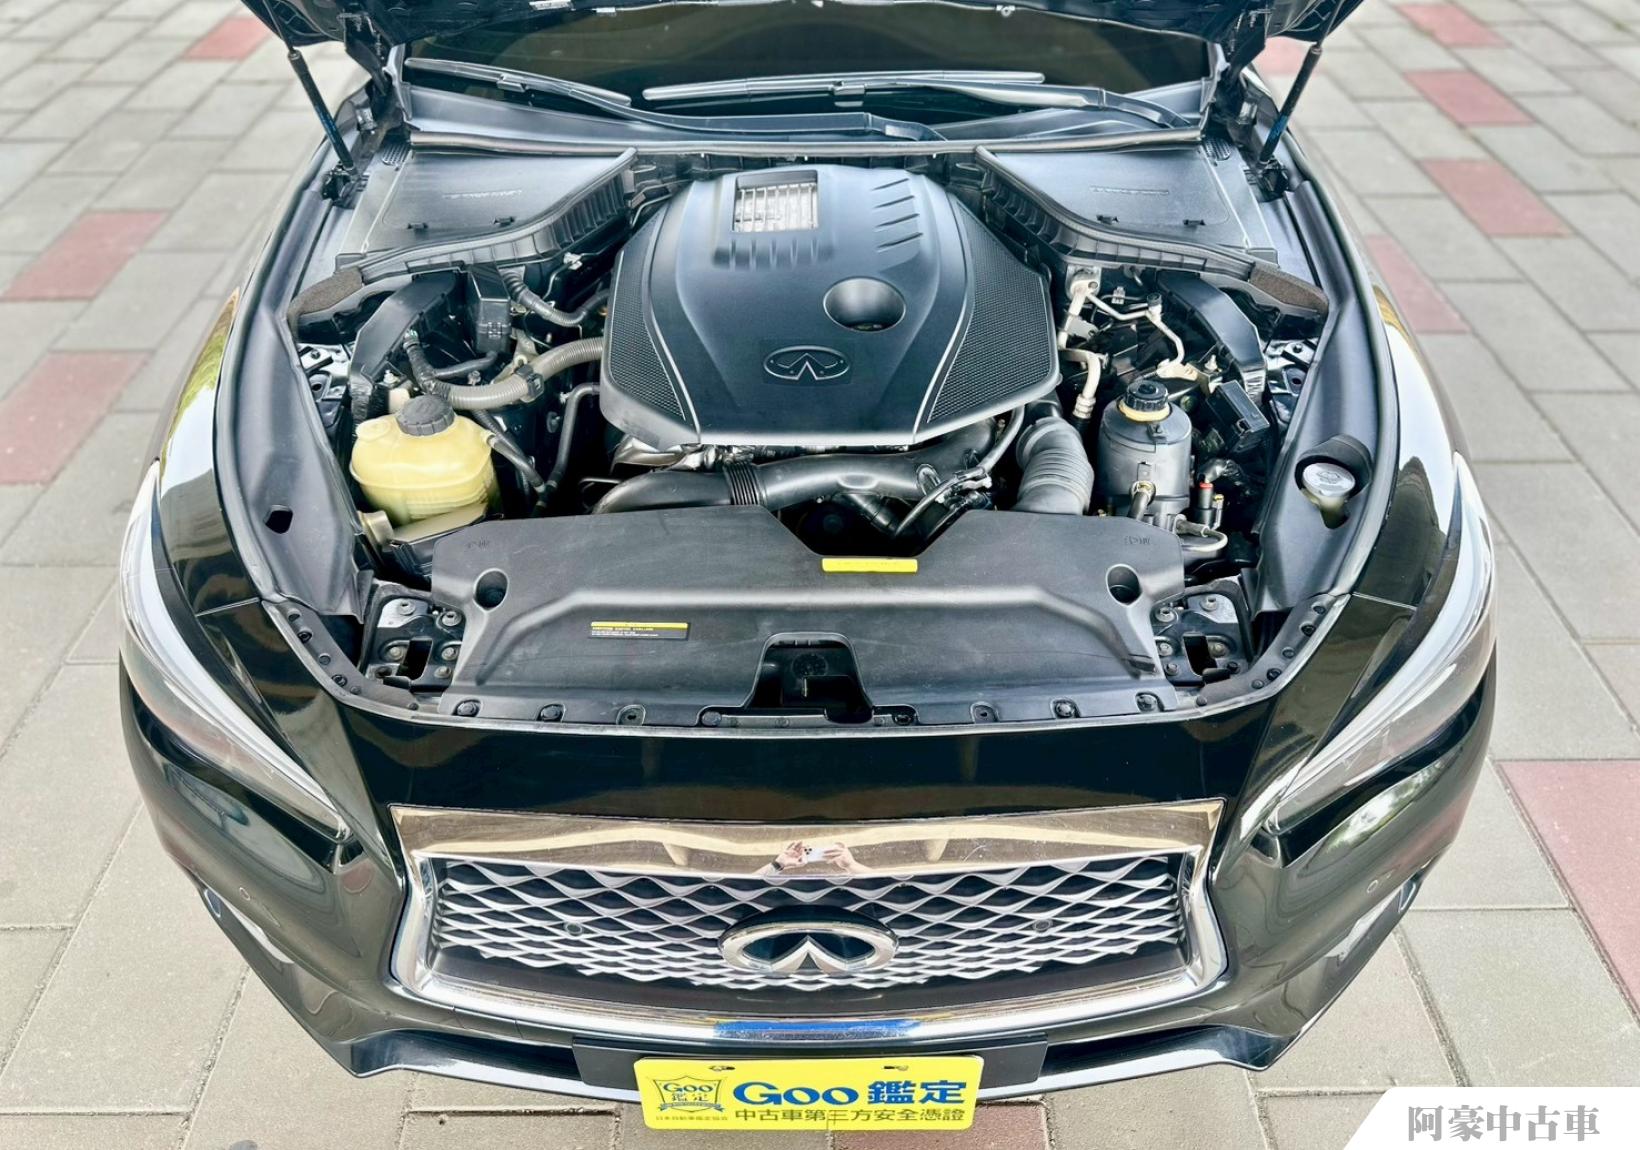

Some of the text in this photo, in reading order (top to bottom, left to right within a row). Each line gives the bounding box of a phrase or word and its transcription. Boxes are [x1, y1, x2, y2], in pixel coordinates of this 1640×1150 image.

[663, 1082, 714, 1093] Goo
[733, 1079, 967, 1106] Goo 鑑定
[735, 1108, 966, 1122] 中古車第三方安全憑證
